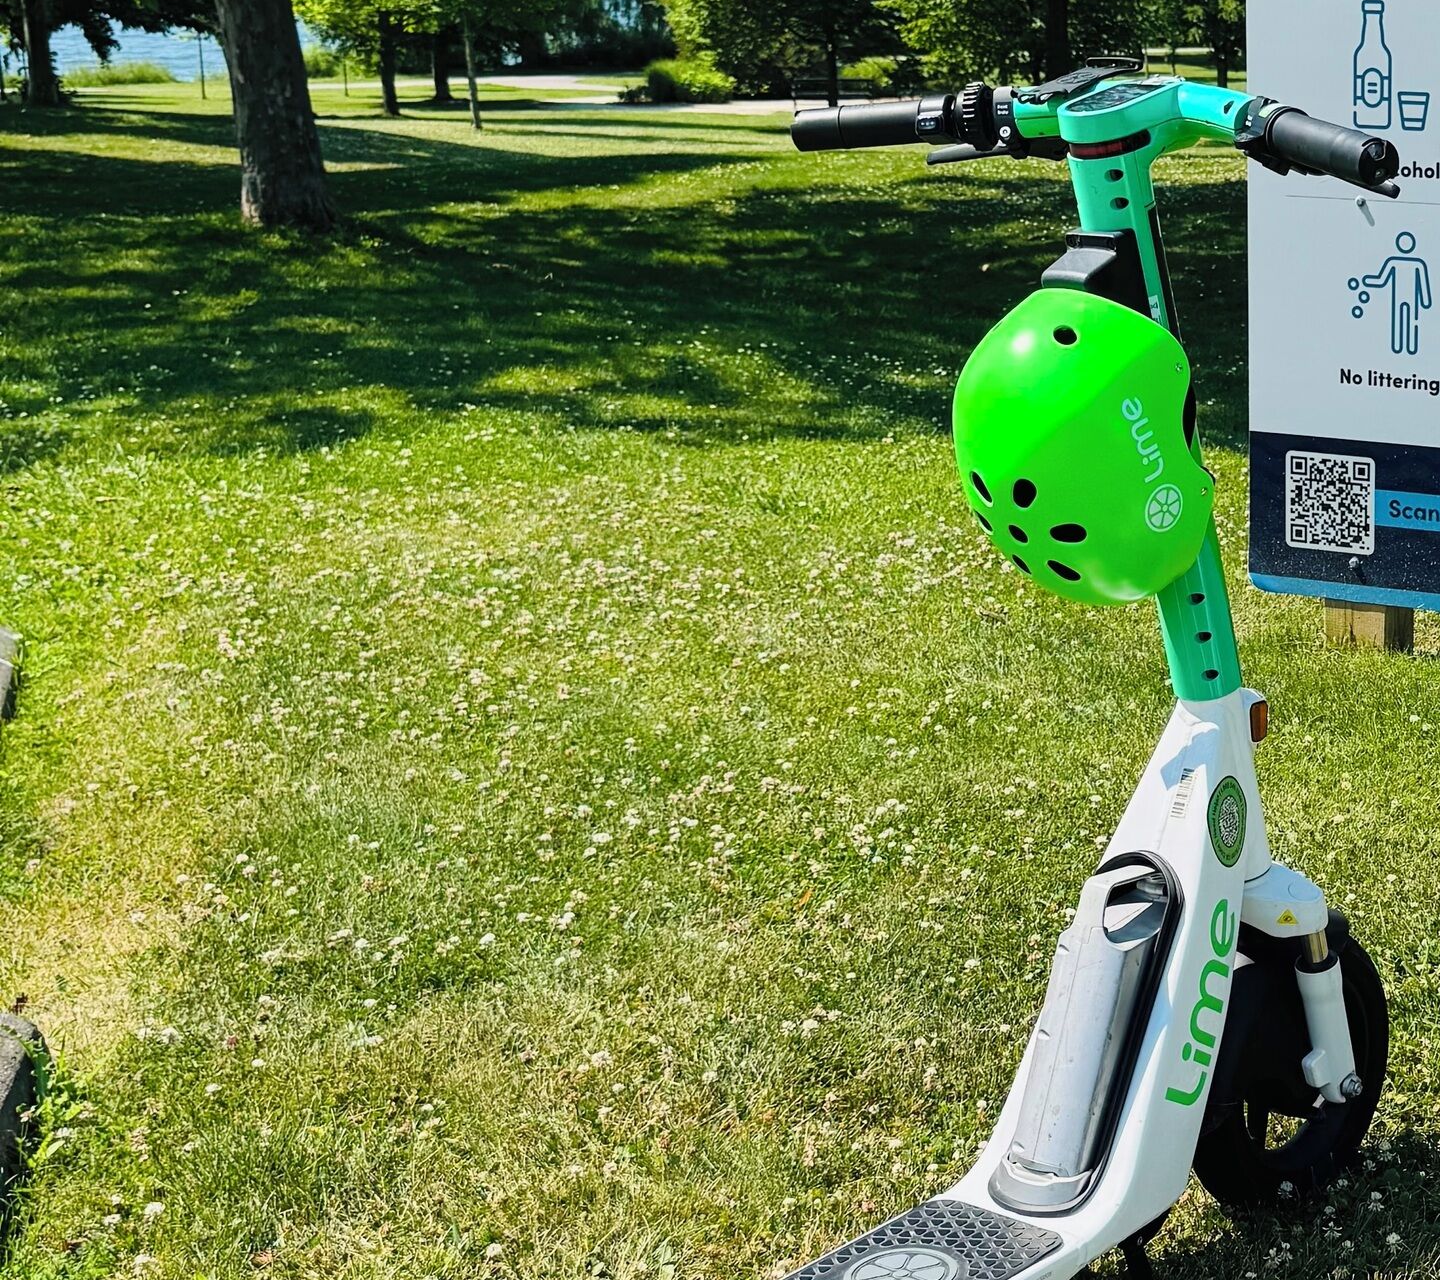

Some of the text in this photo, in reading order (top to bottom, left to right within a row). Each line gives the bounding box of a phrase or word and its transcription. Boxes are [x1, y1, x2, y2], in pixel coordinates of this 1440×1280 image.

[1401, 161, 1440, 179] ohol
[1340, 368, 1440, 396] No littering
[1121, 396, 1166, 484] Lime
[1388, 499, 1440, 522] Scan
[1165, 898, 1240, 1107] Lime
